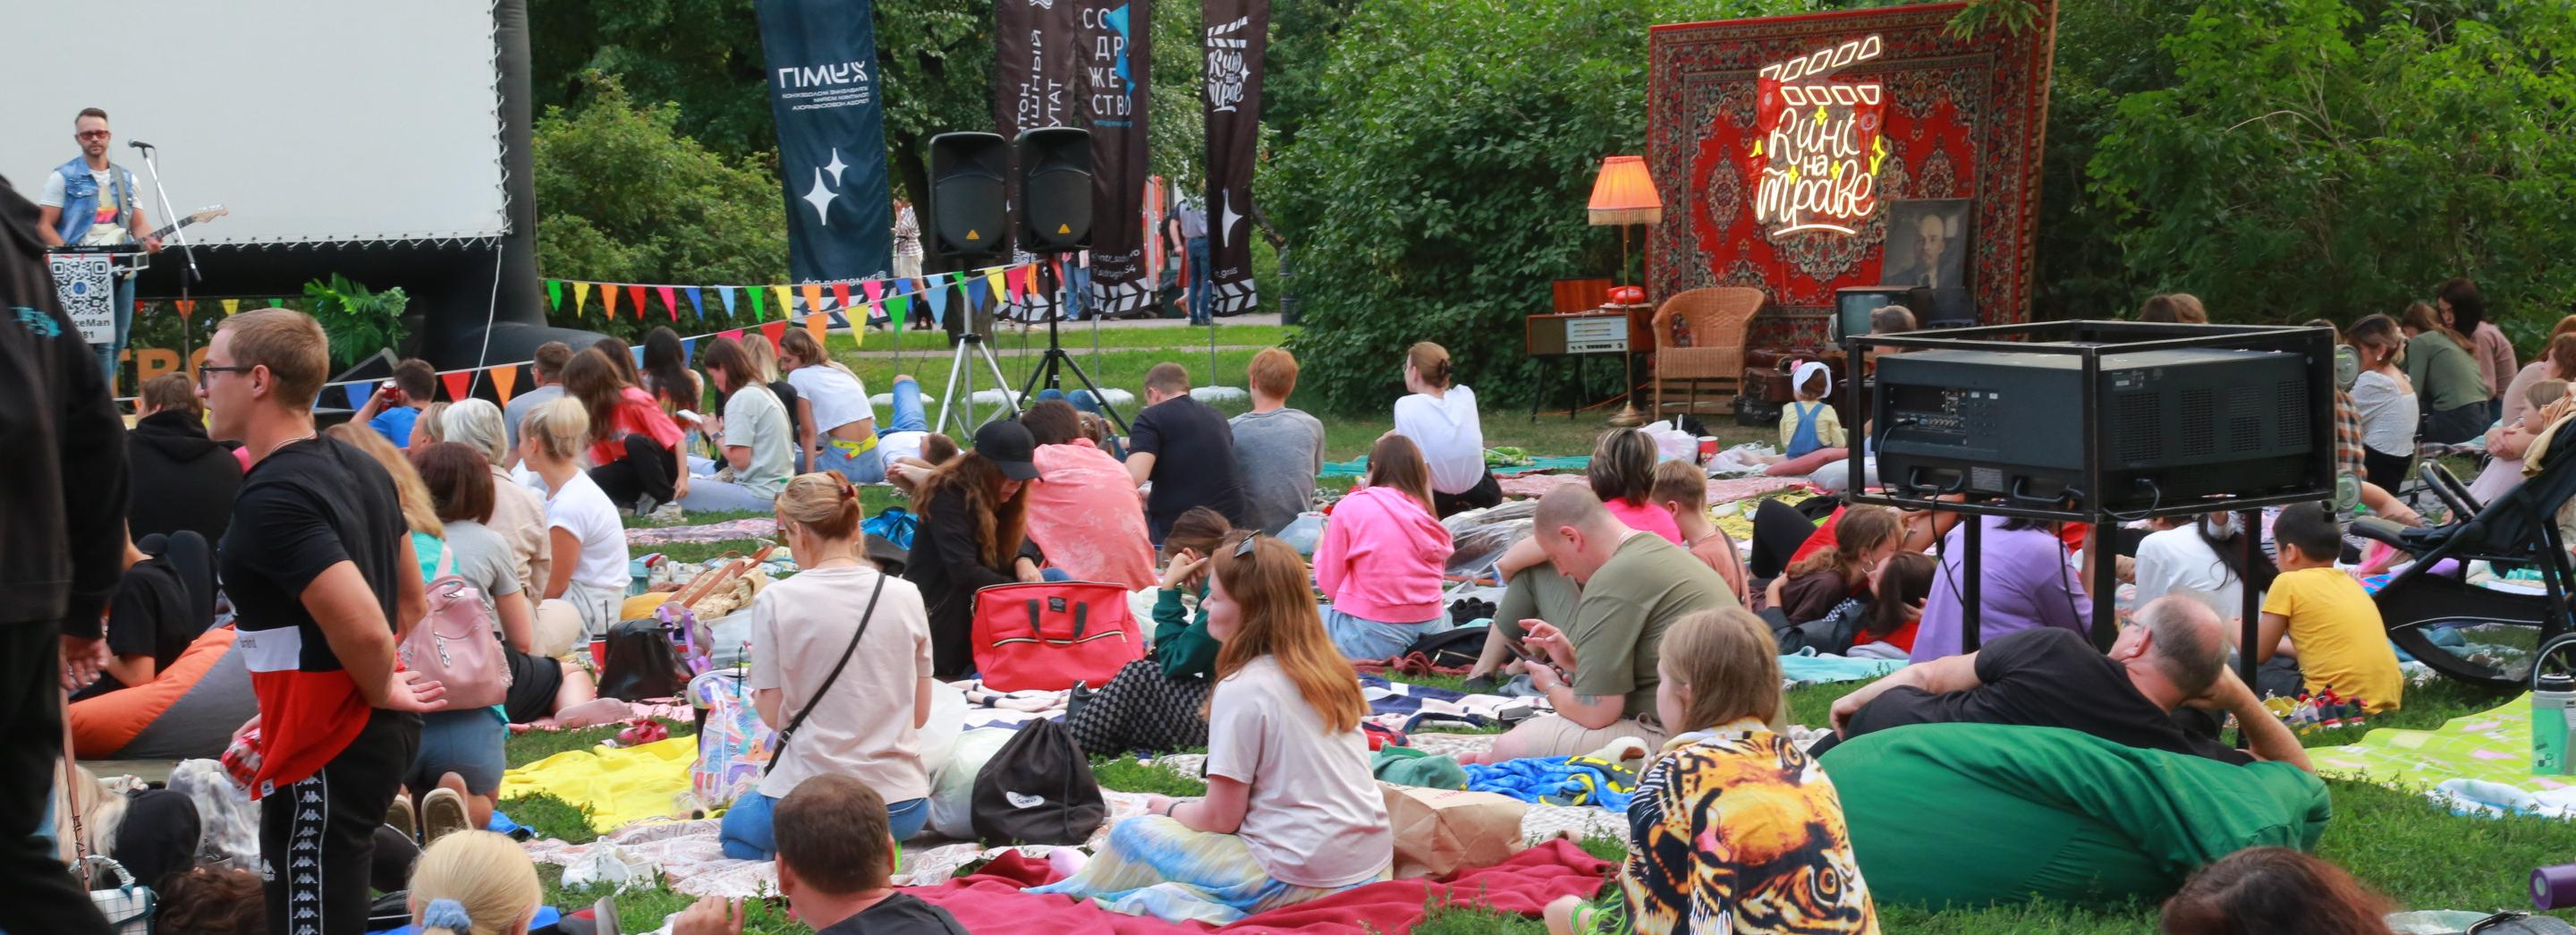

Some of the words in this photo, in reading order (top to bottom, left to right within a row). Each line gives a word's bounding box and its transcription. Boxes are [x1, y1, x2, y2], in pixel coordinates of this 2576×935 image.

[1095, 36, 1129, 61] ДР
[1030, 30, 1042, 126] ШНЫЙ
[1089, 67, 1119, 88] ЖЕ
[1048, 79, 1063, 127] УТАТ
[1092, 94, 1131, 115] СТВО
[1802, 154, 1828, 177] на
[1756, 159, 1876, 228] траве
[73, 319, 111, 327] ceMan
